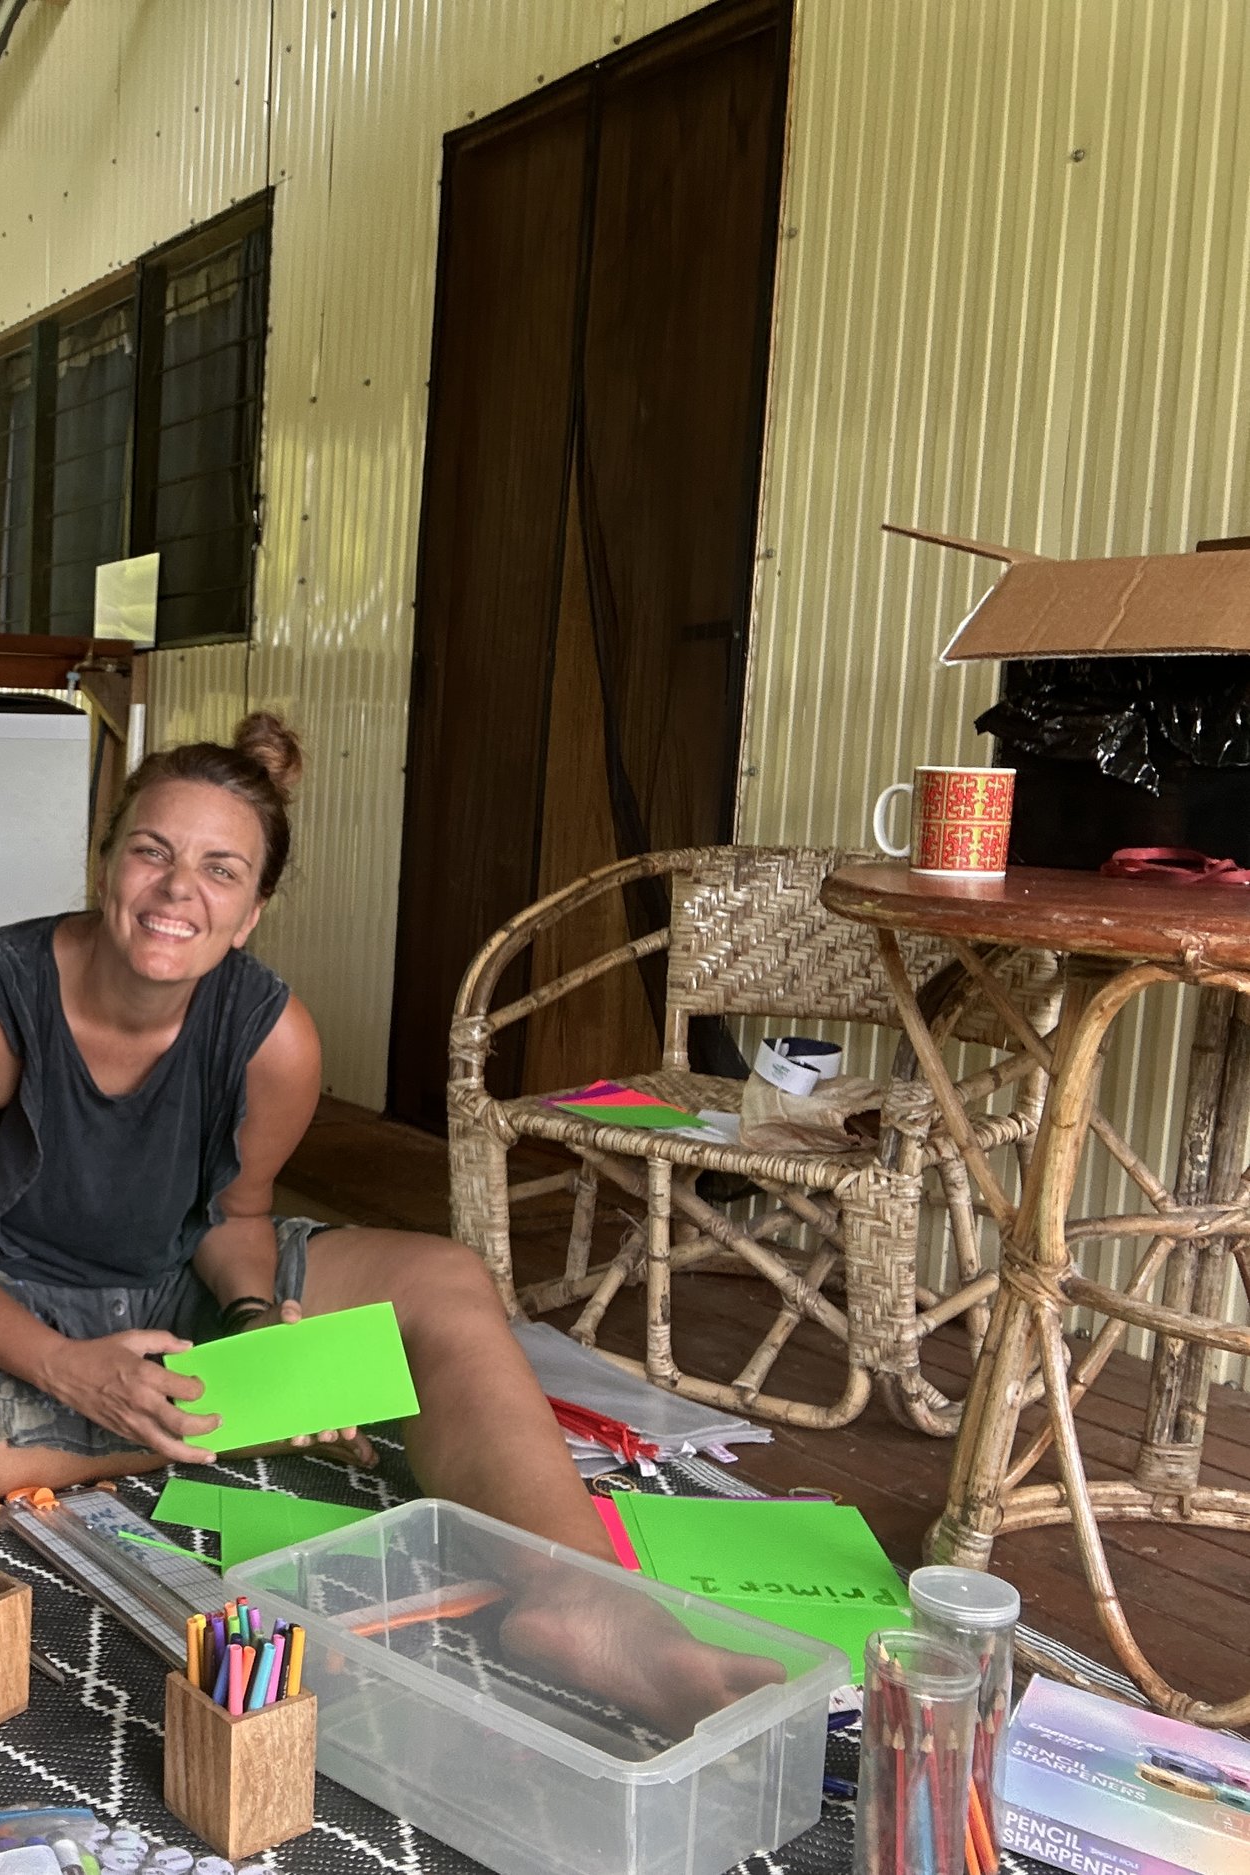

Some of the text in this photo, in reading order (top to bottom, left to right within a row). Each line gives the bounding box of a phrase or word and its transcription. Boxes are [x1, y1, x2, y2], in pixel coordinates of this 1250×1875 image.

[738, 1580, 898, 1606] Primer
[1011, 1746, 1147, 1801] SHARPENERS
[1014, 1740, 1090, 1773] PENCIL
[1002, 1829, 1138, 1875] SHARPENER
[1005, 1810, 1083, 1852] PENCIL
